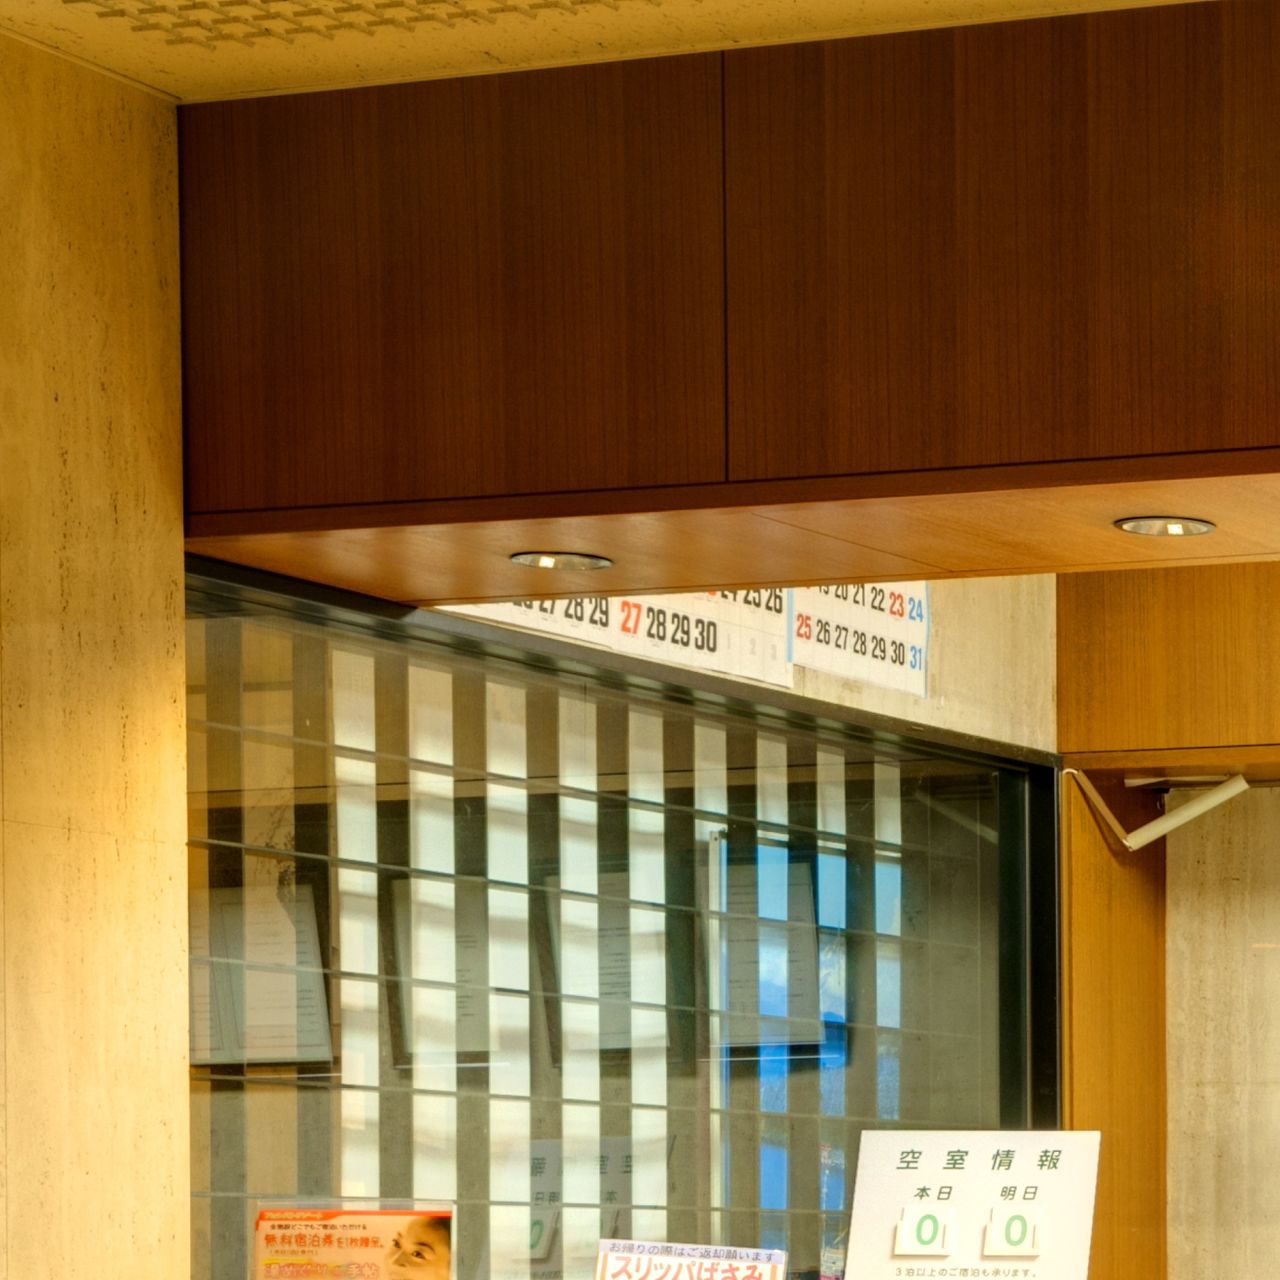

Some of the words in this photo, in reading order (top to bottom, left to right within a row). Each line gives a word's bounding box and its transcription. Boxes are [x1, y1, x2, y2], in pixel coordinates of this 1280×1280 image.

[588, 597, 609, 627] 29
[871, 585, 885, 611] 22
[889, 591, 905, 618] 23
[908, 597, 924, 622] 24
[620, 600, 642, 635] 27
[646, 607, 667, 641] 28
[671, 613, 691, 647] 29
[695, 619, 717, 653] 30
[796, 613, 812, 640] 25
[816, 619, 831, 645] 26
[835, 624, 849, 650] 27
[853, 630, 867, 656] 28
[871, 635, 886, 661] 29
[890, 640, 905, 666] 30
[909, 645, 923, 671] 31
[895, 1149, 1062, 1171] 空室情報
[913, 1186, 953, 1201] 本日
[999, 1186, 1038, 1201] 明日
[915, 1214, 939, 1246] 0
[1004, 1214, 1028, 1247] 0
[609, 1241, 776, 1263] お帰りの際はご返却願います
